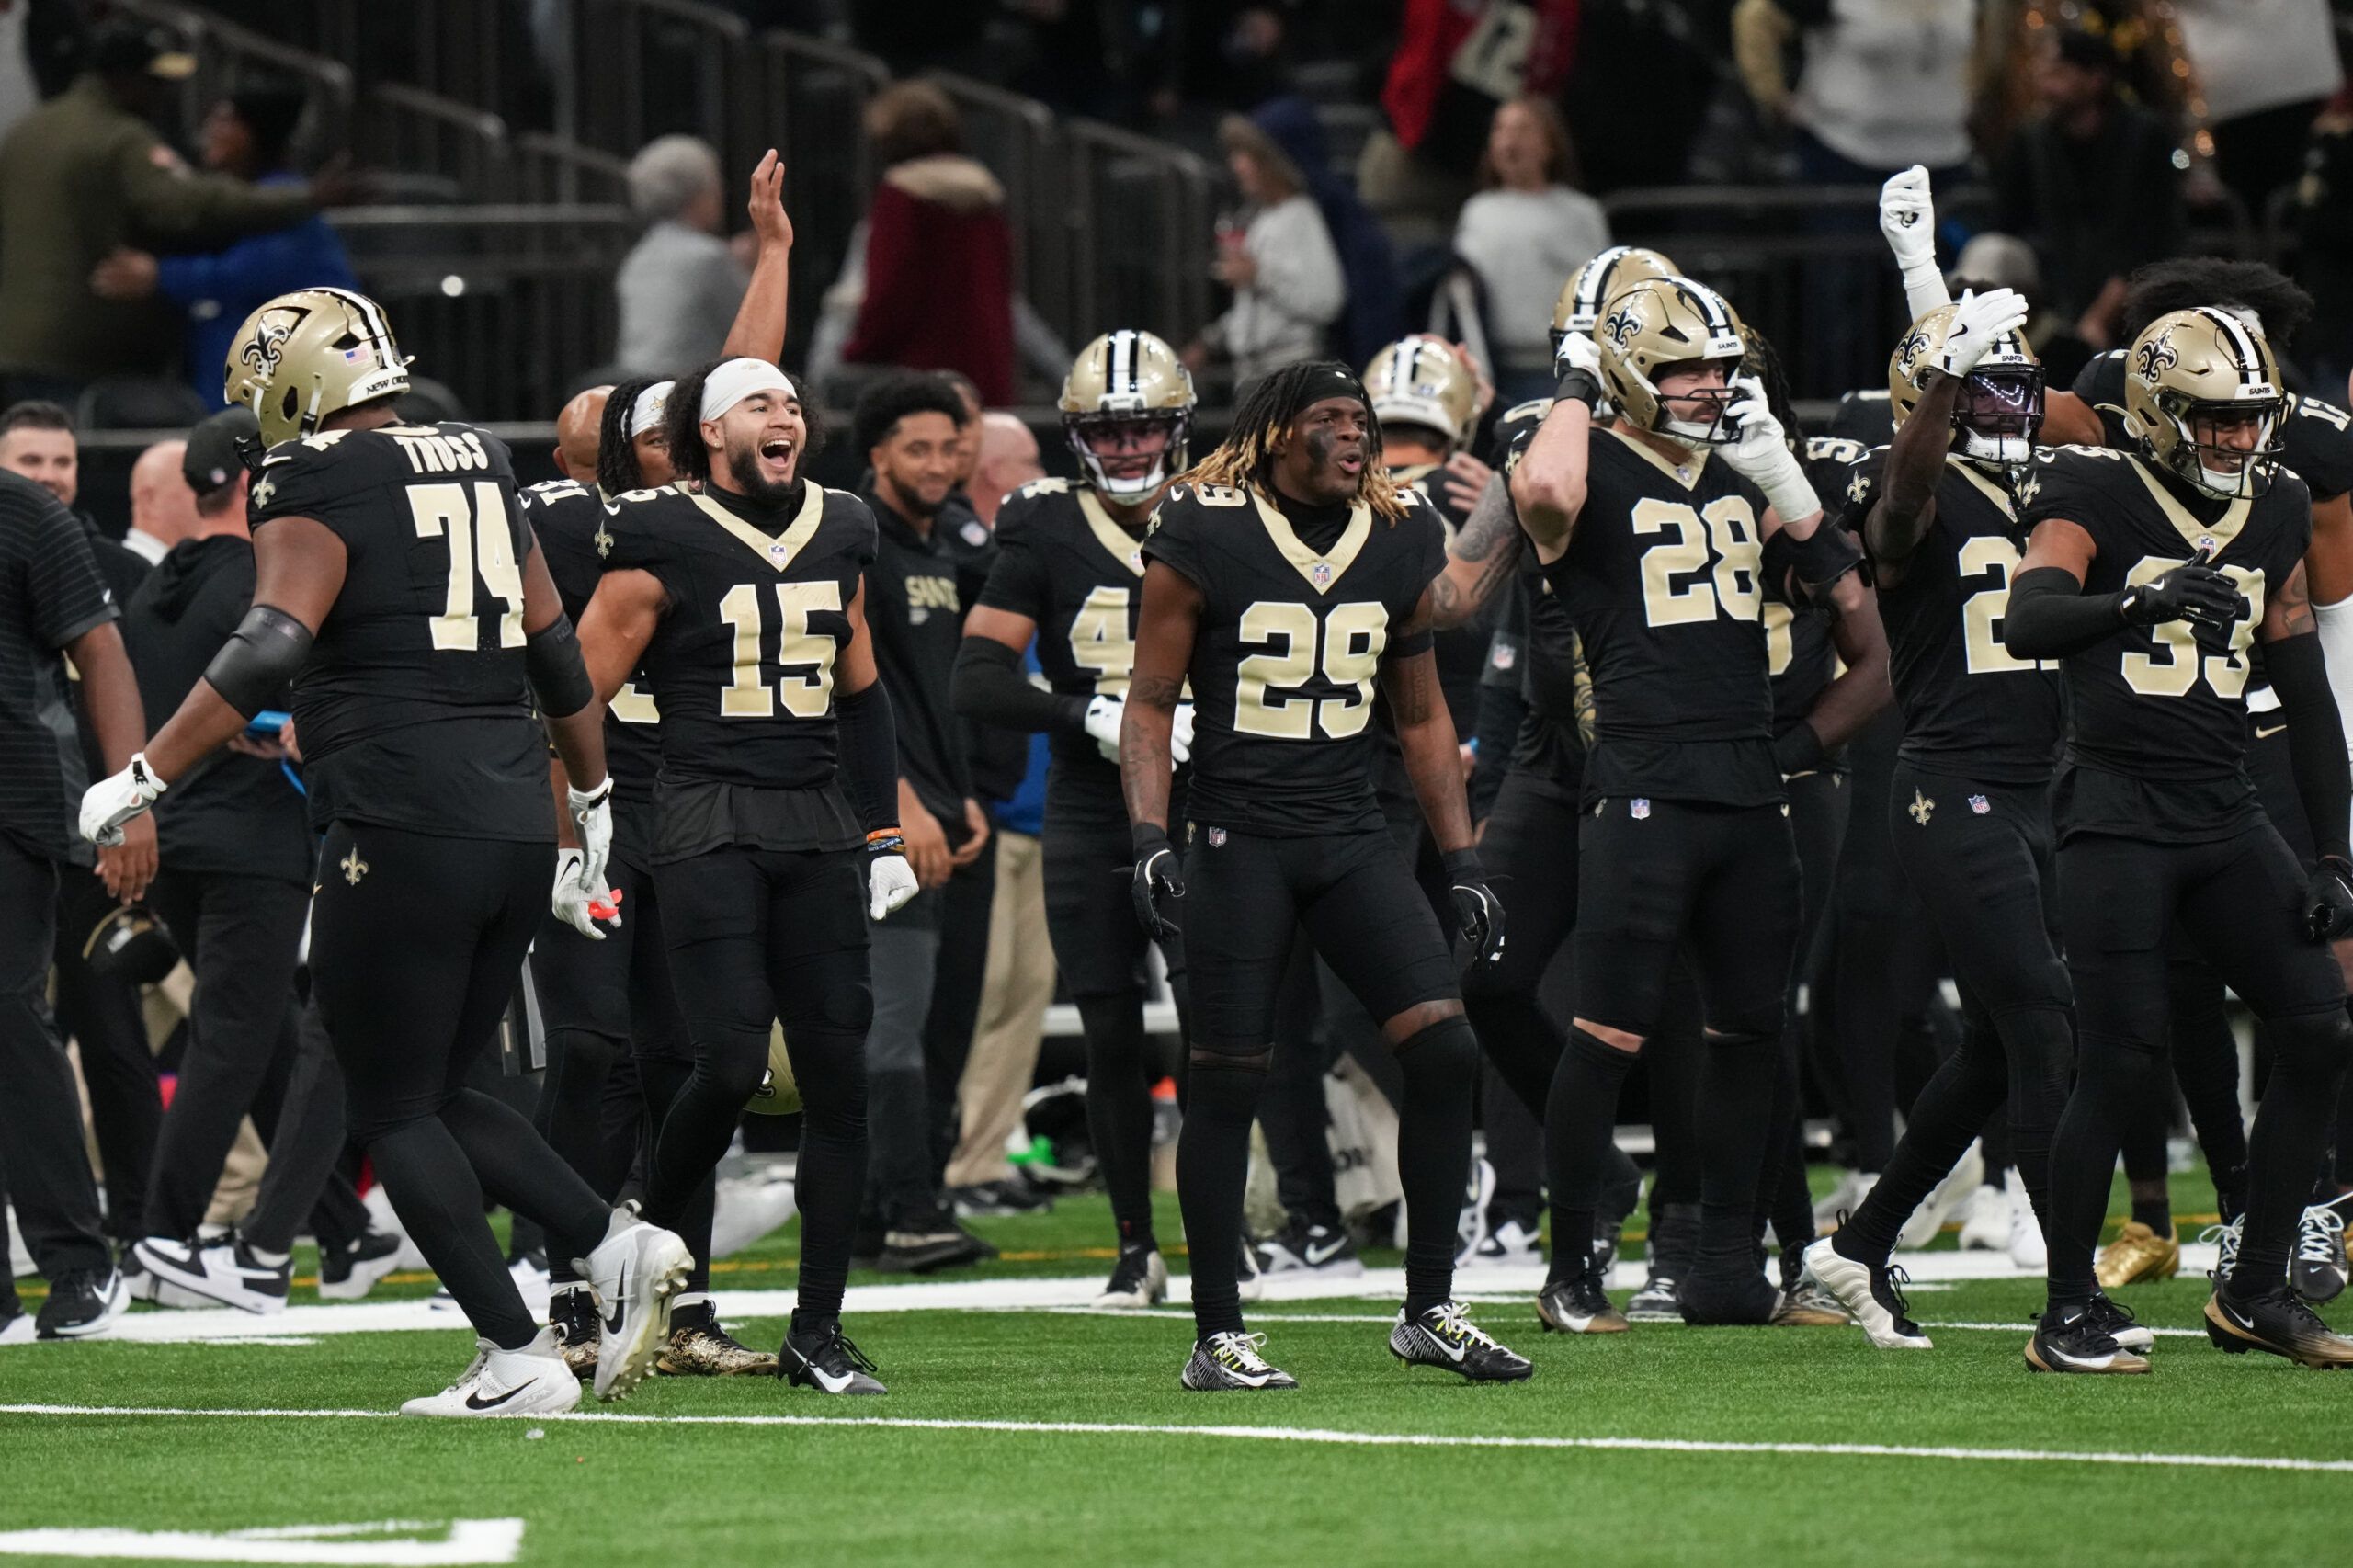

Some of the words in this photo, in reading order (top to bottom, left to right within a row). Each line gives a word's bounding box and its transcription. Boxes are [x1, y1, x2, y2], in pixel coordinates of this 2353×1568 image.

[366, 379, 389, 395] NEW
[1718, 341, 1738, 349] SAINTS
[2249, 387, 2270, 395] SAINTS
[393, 432, 488, 473] TRUSS
[405, 482, 527, 651] 74
[1631, 495, 1763, 628] 28
[1959, 536, 2059, 674] 2
[720, 580, 842, 717] 15
[1233, 601, 1389, 739] 29
